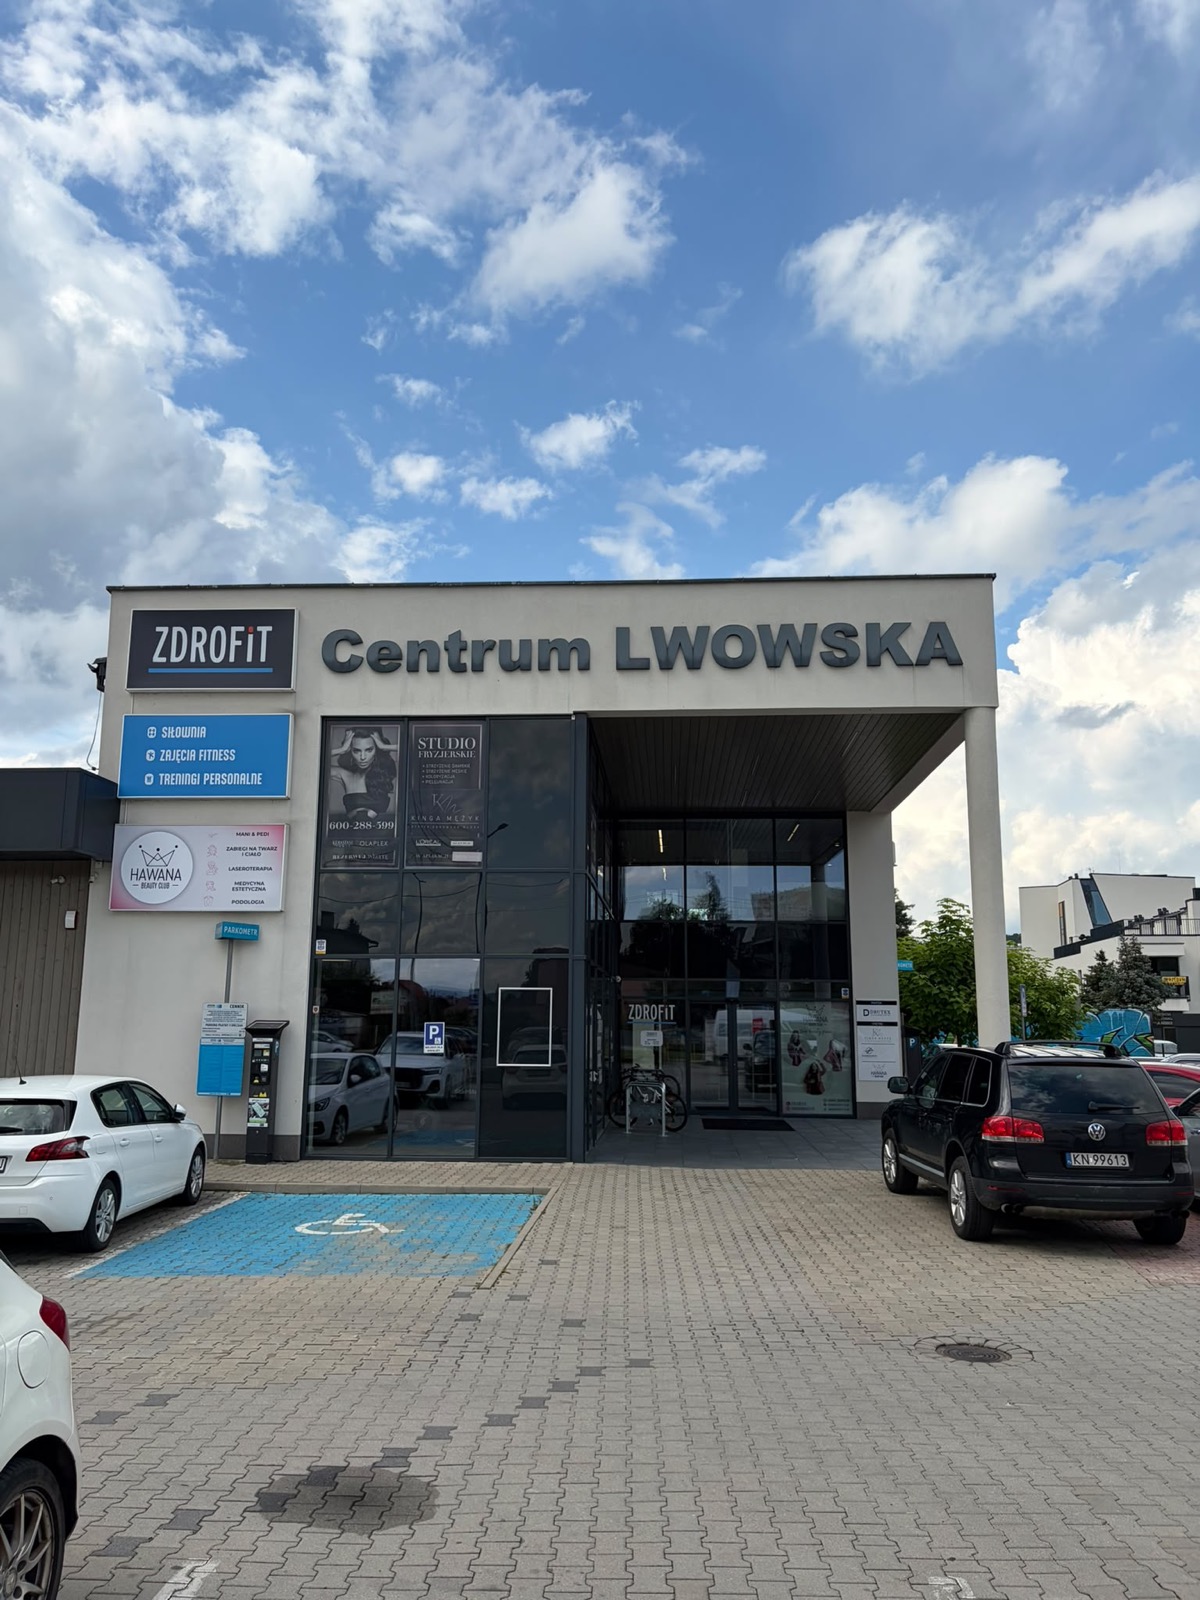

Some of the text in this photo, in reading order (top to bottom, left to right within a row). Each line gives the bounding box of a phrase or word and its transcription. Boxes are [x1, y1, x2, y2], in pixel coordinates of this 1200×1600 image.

[322, 622, 964, 674] Centrum LWOWSKA
[161, 726, 206, 739] SIŁOWNIA
[418, 737, 476, 750] STUDIO
[159, 749, 236, 763] ZAJĘCIA FITNESS
[418, 750, 476, 759] FRYZJERSKIE
[159, 773, 263, 785] TRENINGI PERSONALNE
[329, 821, 395, 830] 600-288-599
[130, 868, 182, 881] HAWANA
[223, 925, 258, 936] PARKOMETR
[429, 1025, 439, 1039] P
[909, 1037, 916, 1047] P
[1072, 1153, 1127, 1166] KN 99613
